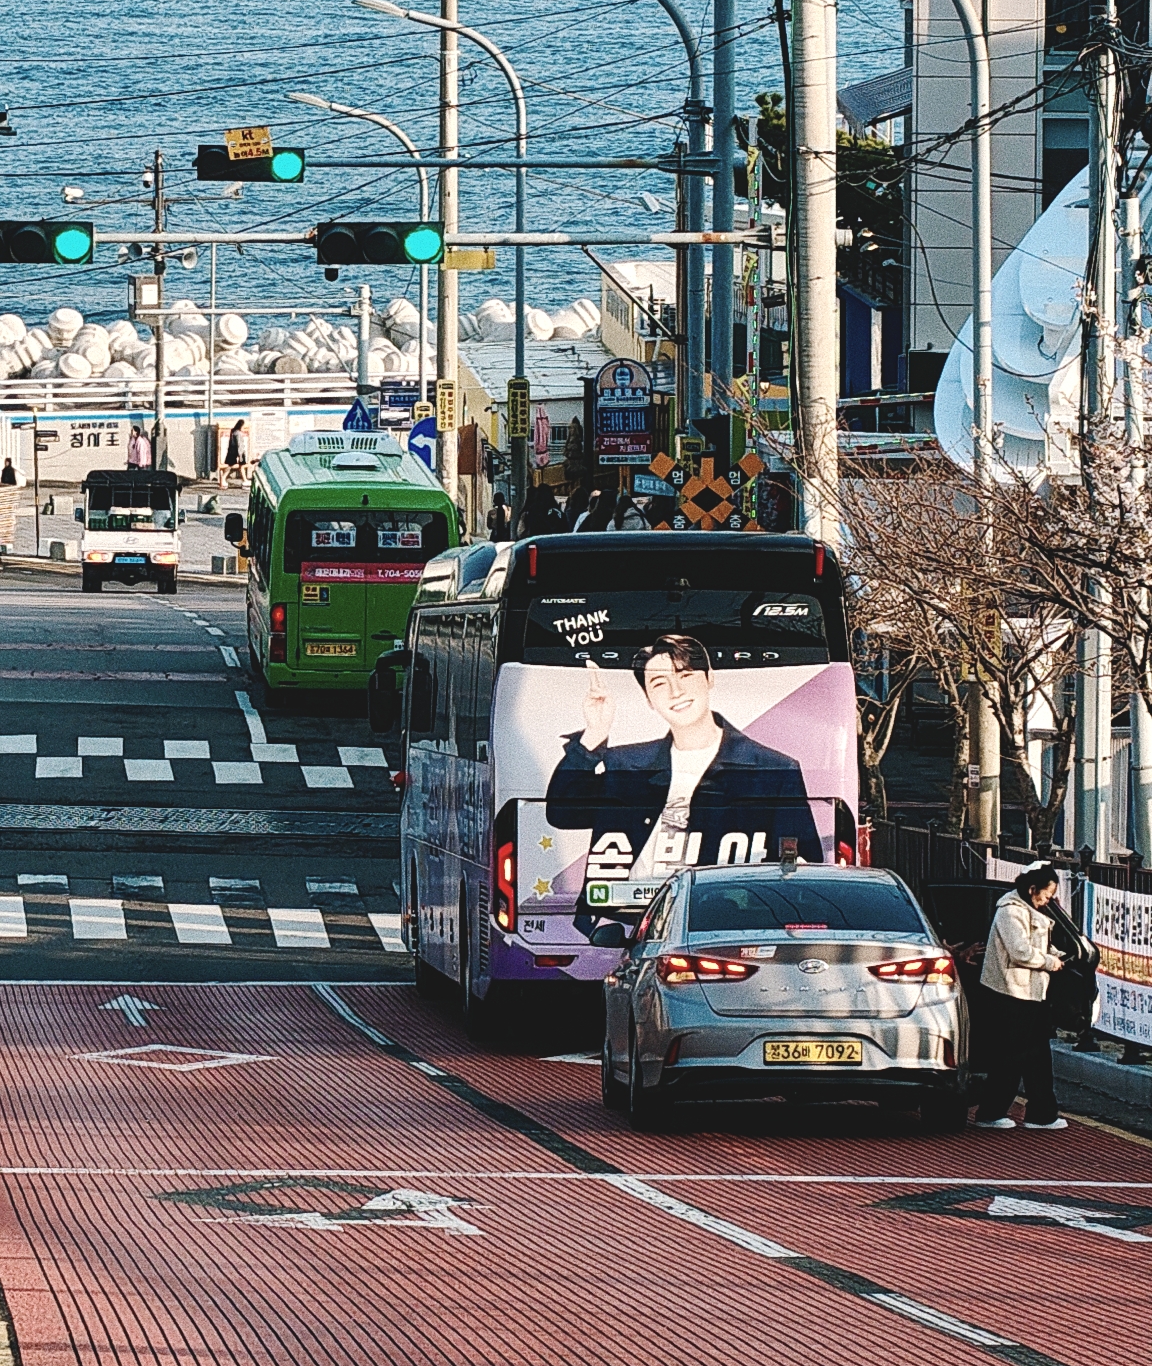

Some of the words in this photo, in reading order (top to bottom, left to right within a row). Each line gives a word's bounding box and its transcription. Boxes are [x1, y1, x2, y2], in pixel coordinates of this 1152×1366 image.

[241, 129, 254, 141] kt
[552, 609, 610, 634] THANK
[523, 920, 546, 933] 전세
[814, 1044, 855, 1060] 7092
